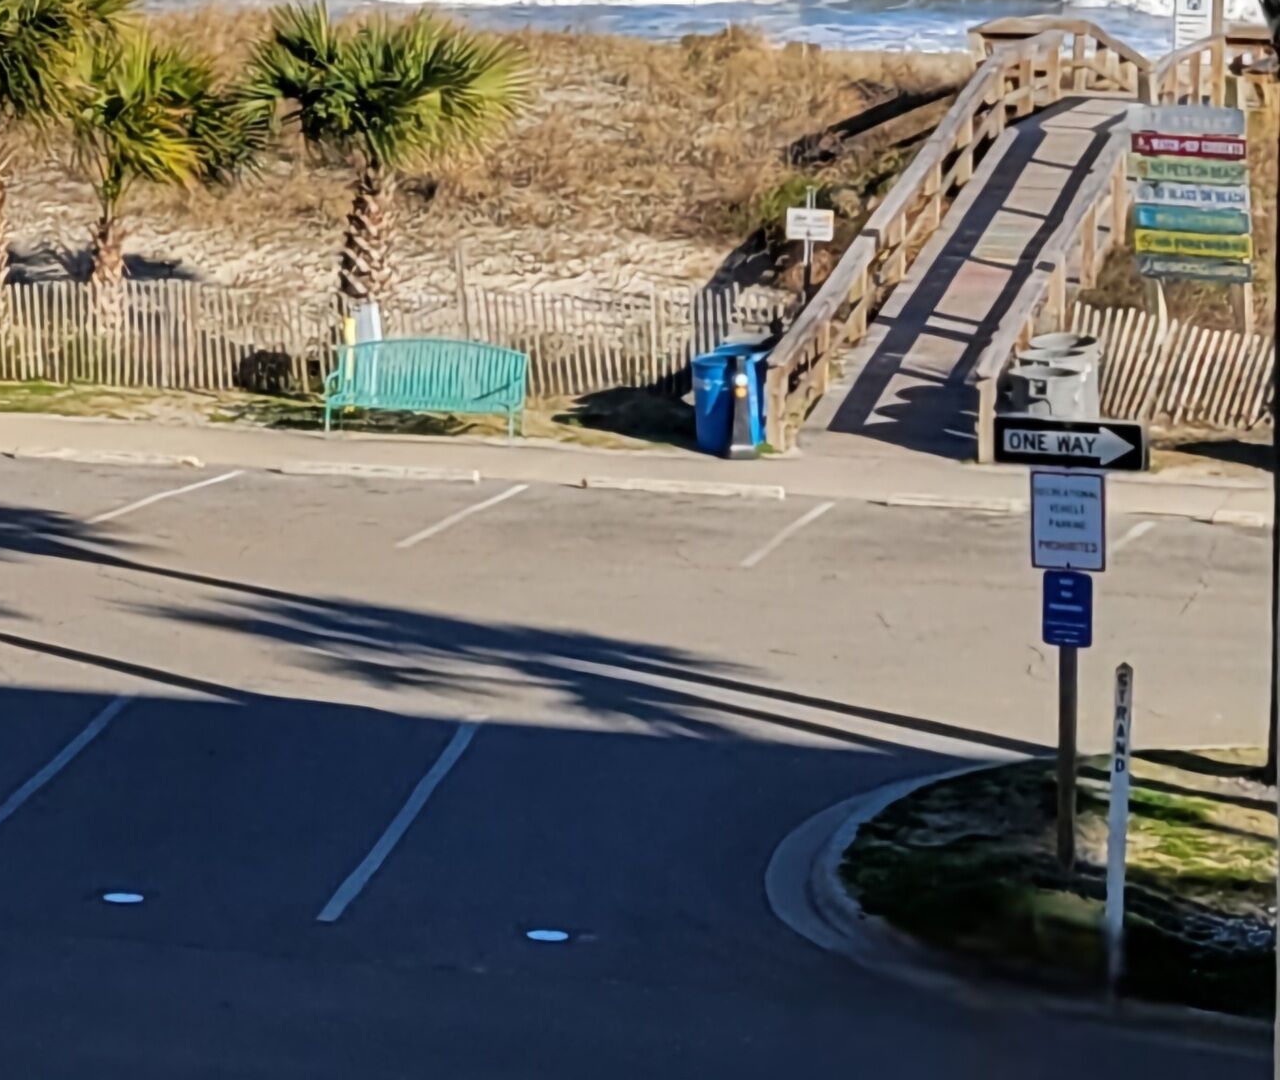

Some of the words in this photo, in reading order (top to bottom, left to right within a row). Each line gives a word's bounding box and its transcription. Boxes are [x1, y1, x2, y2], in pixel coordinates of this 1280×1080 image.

[1009, 432, 1047, 451] ONE
[1056, 435, 1097, 454] WAY
[1038, 540, 1098, 553] PROHIBITED
[1115, 673, 1128, 772] STRAND
